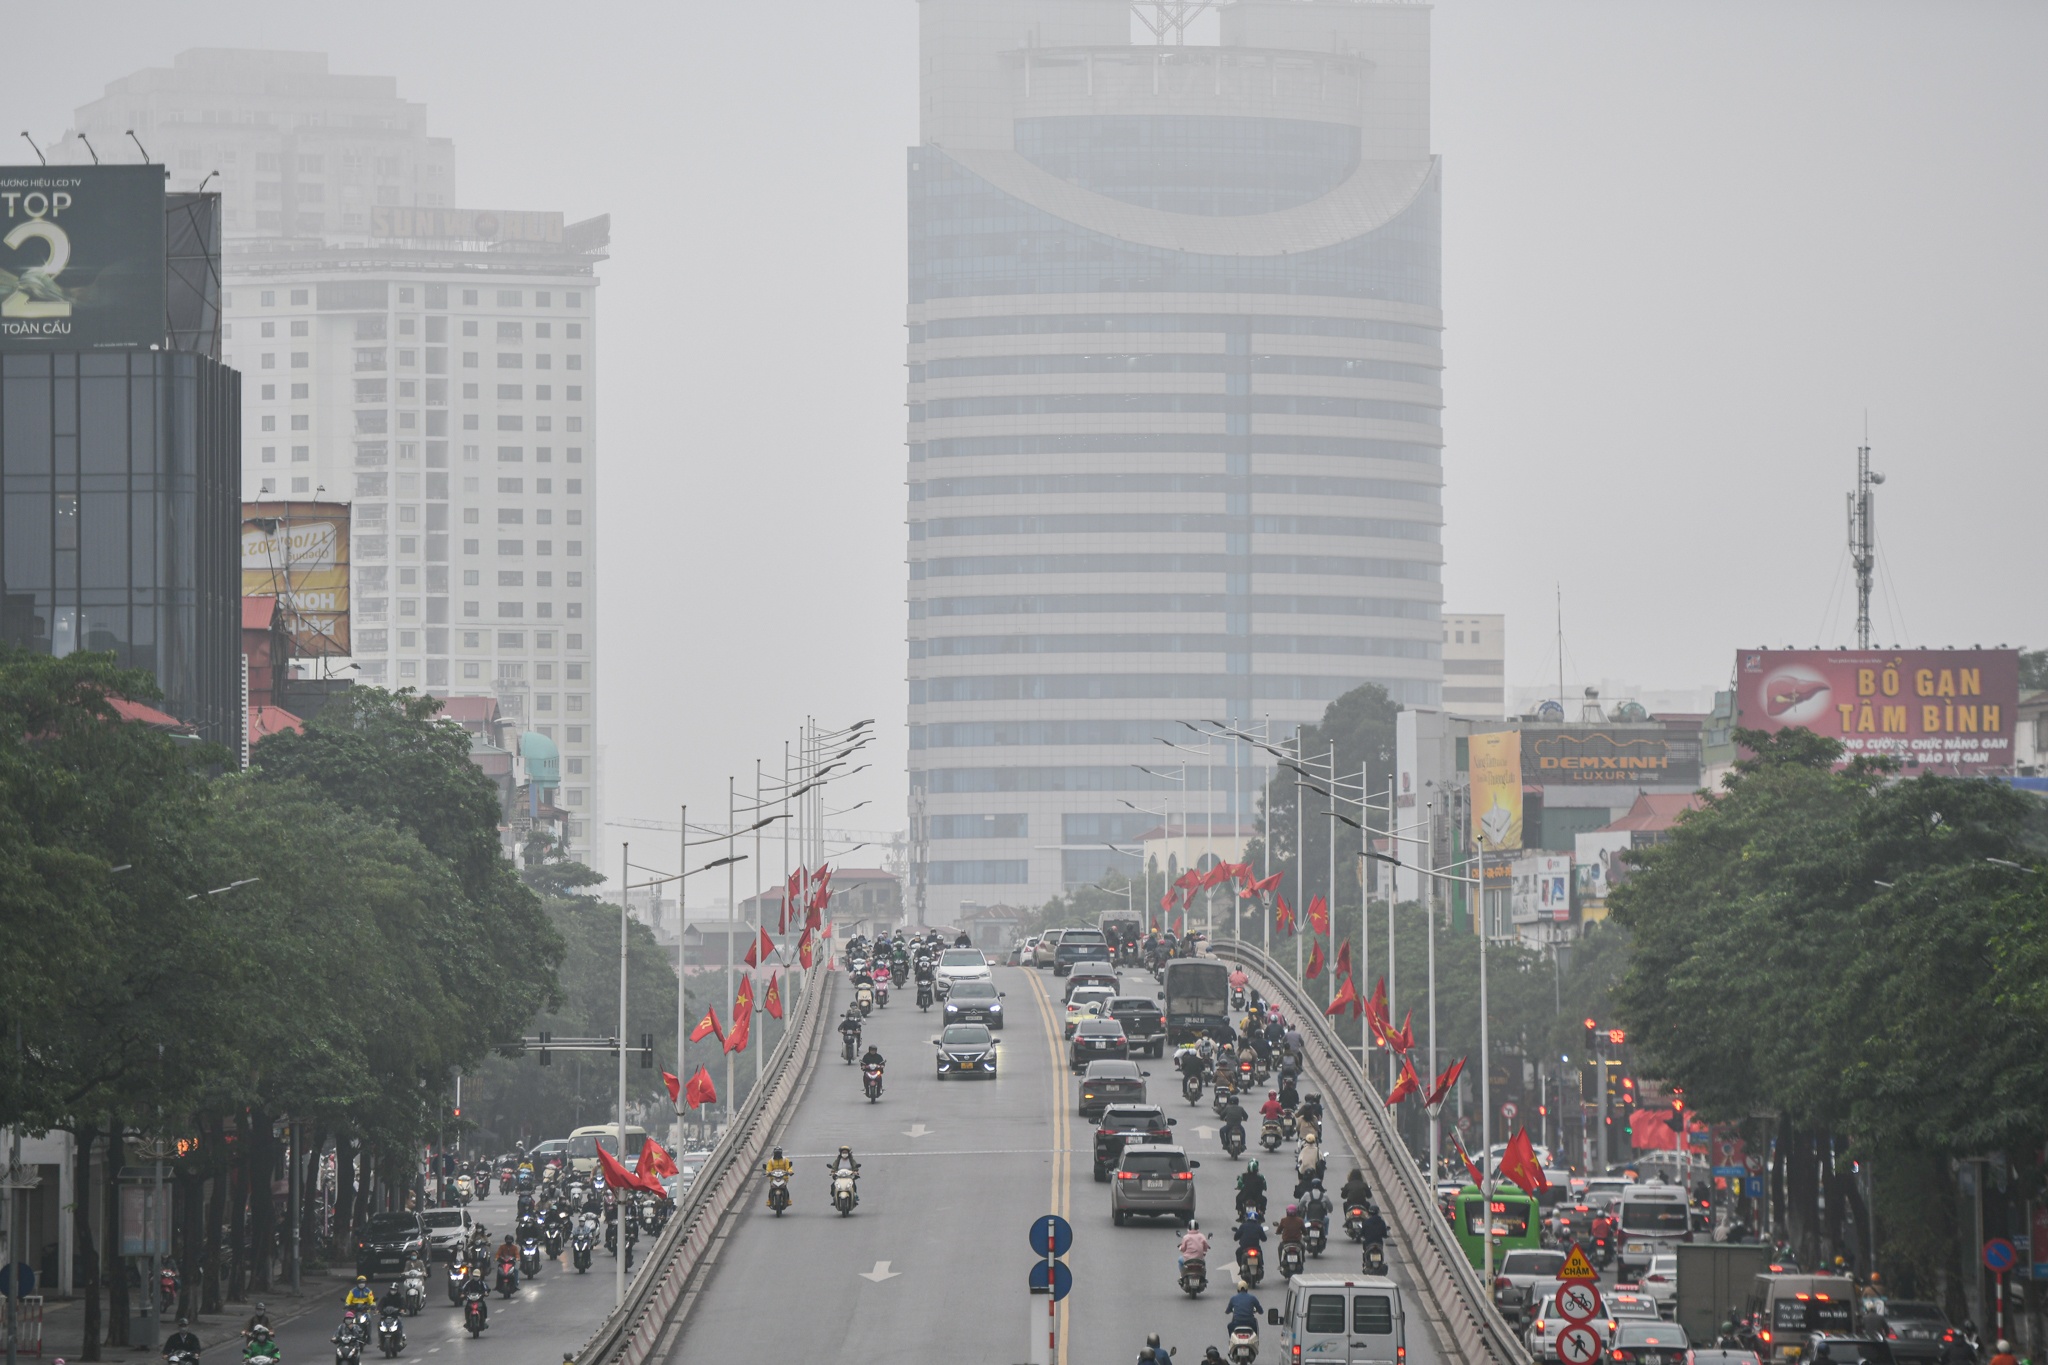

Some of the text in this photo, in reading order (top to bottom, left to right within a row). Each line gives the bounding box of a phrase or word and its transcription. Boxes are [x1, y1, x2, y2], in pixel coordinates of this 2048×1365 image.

[30, 178, 51, 188] HIỆU
[52, 179, 69, 187] LCD
[71, 178, 82, 187] TV
[1, 191, 72, 218] TOP
[2, 219, 73, 318] 2
[1, 319, 72, 335] TOÀN CẦU
[1857, 656, 1982, 697] BỔ GAN
[1837, 698, 2000, 733] TÂM BÌNH
[1911, 736, 1943, 750] CHỨC
[1944, 736, 1980, 750] NĂNG
[1981, 738, 2008, 749] GAN
[1540, 757, 1668, 769] DEMXINH
[1918, 751, 1943, 764] BẢO
[1945, 751, 1961, 764] VỆ
[1962, 752, 1989, 763] GAN
[1573, 771, 1636, 781] LUXURY
[1609, 1029, 1625, 1044] 92
[1571, 1258, 1582, 1266] ĐI
[1564, 1267, 1590, 1277] CHẬM
